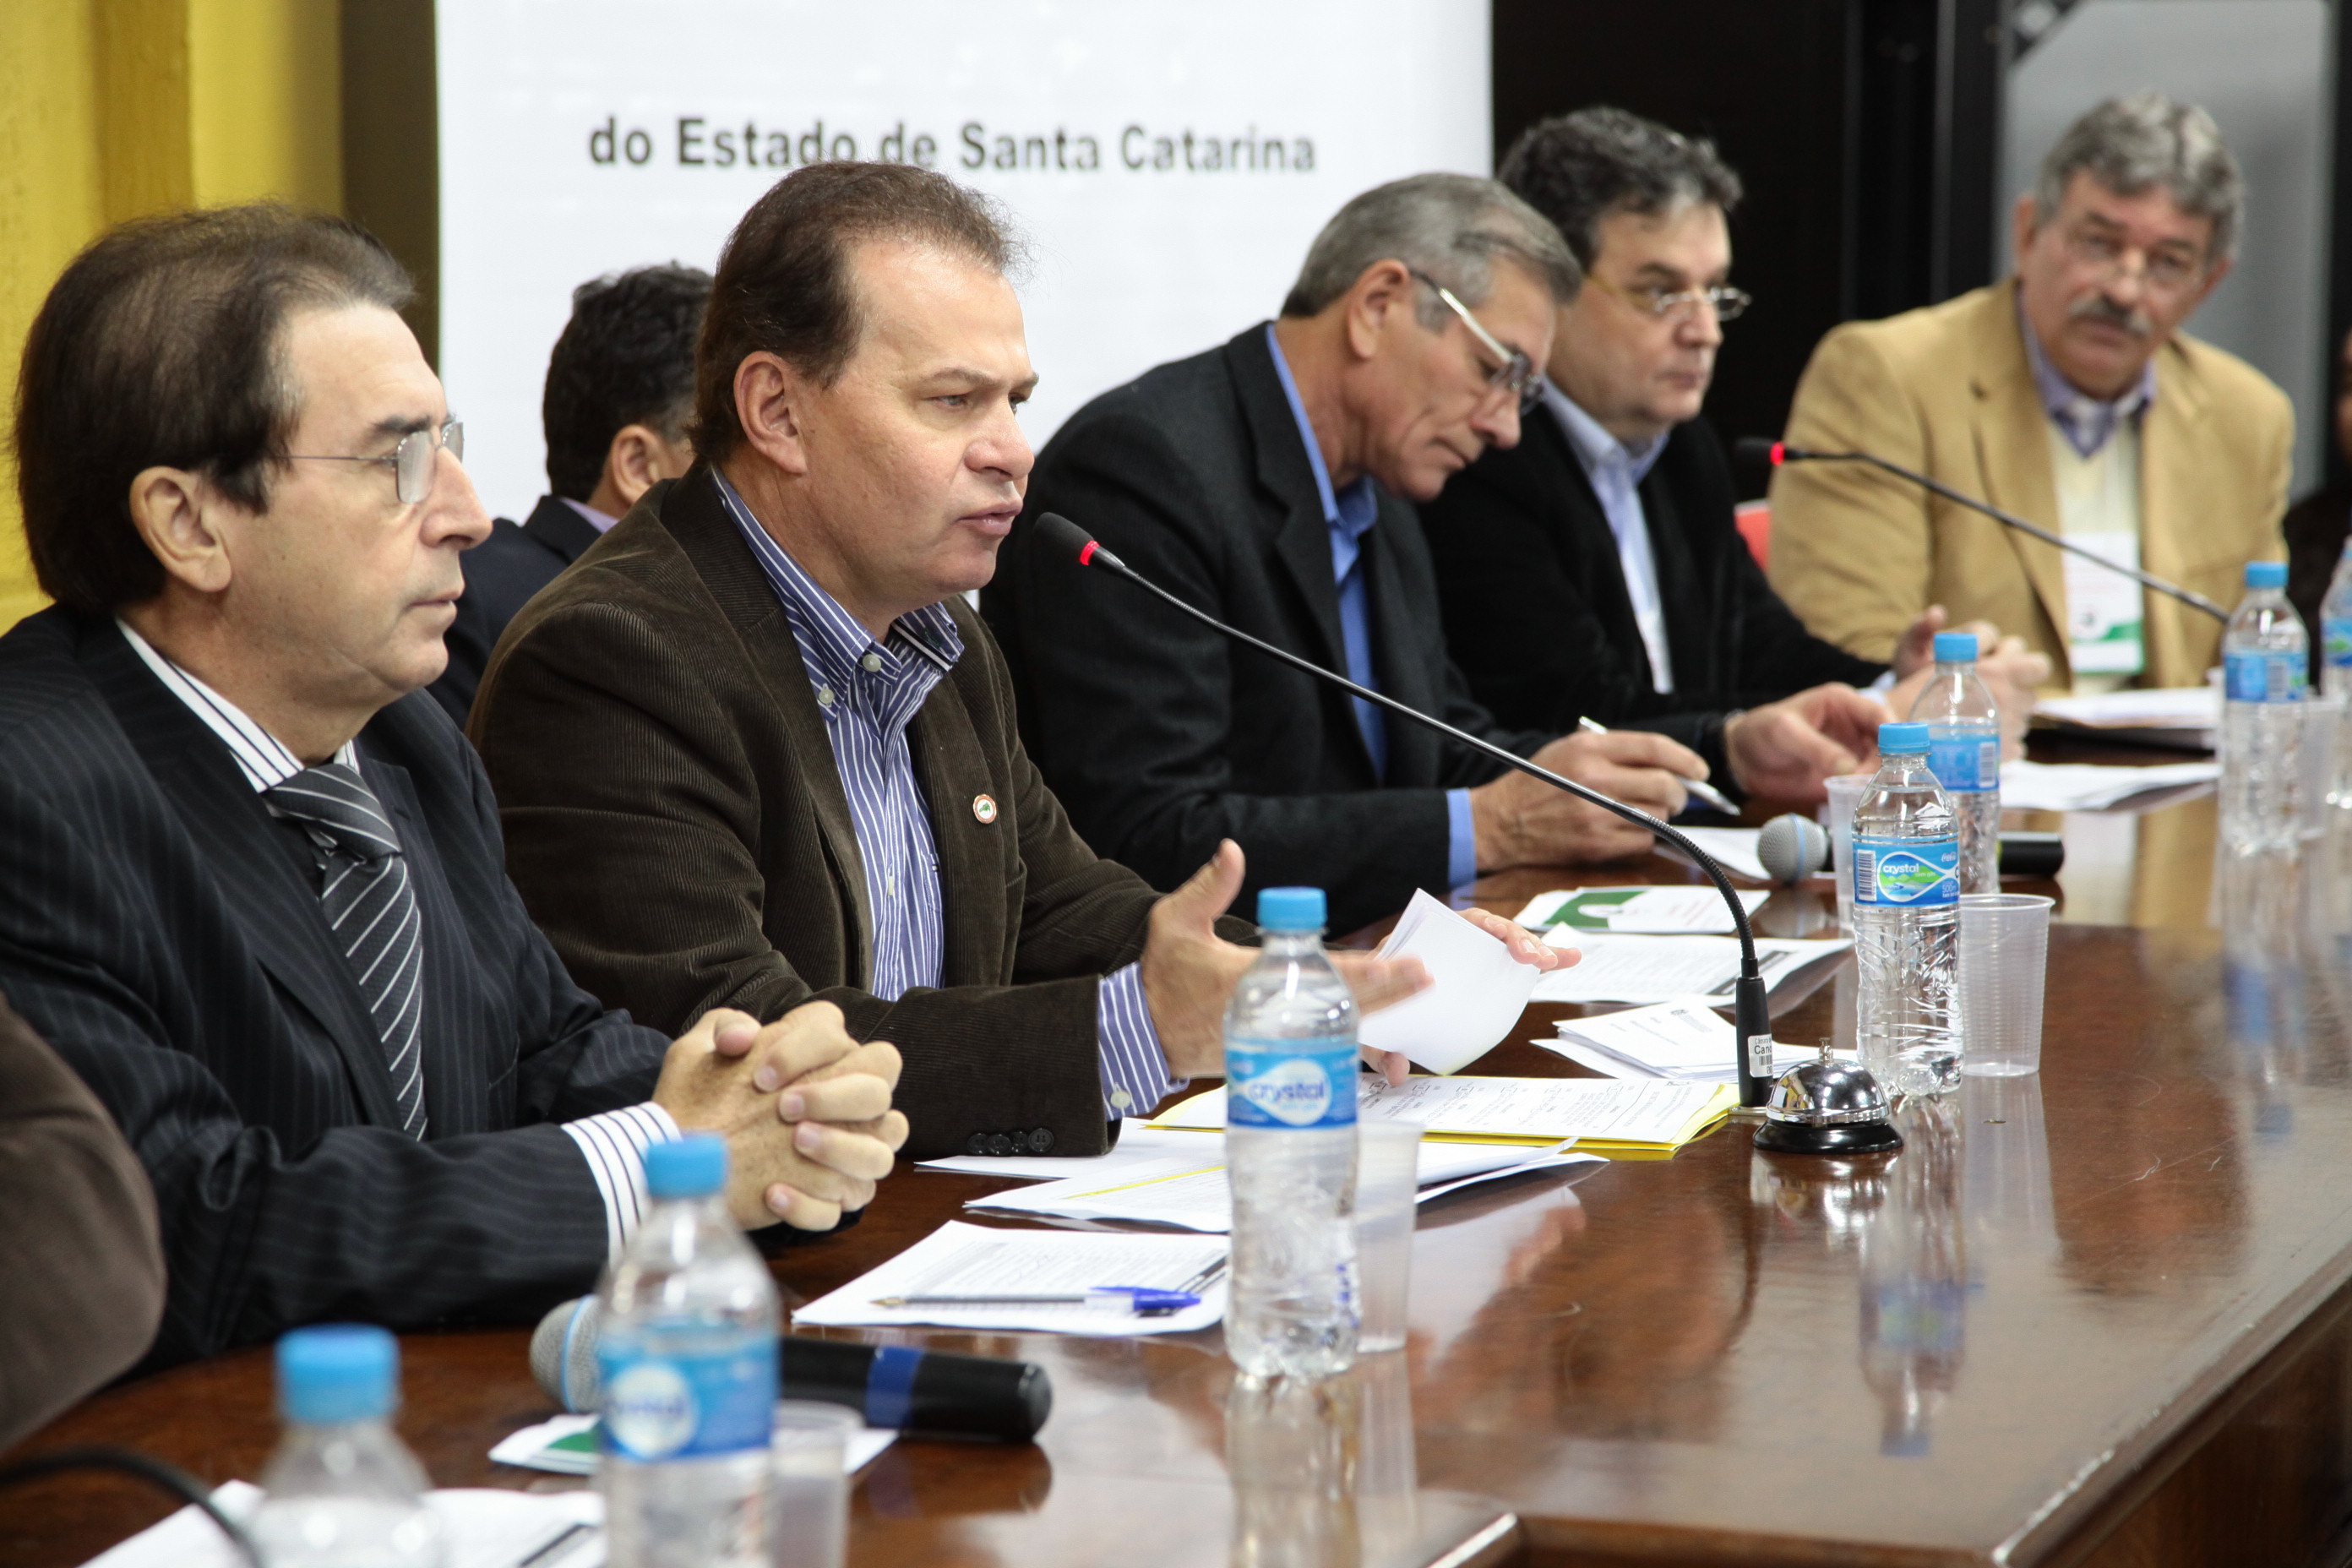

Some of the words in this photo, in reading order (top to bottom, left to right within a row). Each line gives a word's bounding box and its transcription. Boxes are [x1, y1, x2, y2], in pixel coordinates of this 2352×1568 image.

[588, 114, 653, 166] do
[678, 117, 857, 166] Estado
[880, 121, 937, 166] de
[960, 121, 1098, 170] Santa
[1120, 123, 1315, 171] Catarina
[1882, 863, 1919, 874] crystal
[1249, 1080, 1326, 1102] crystal
